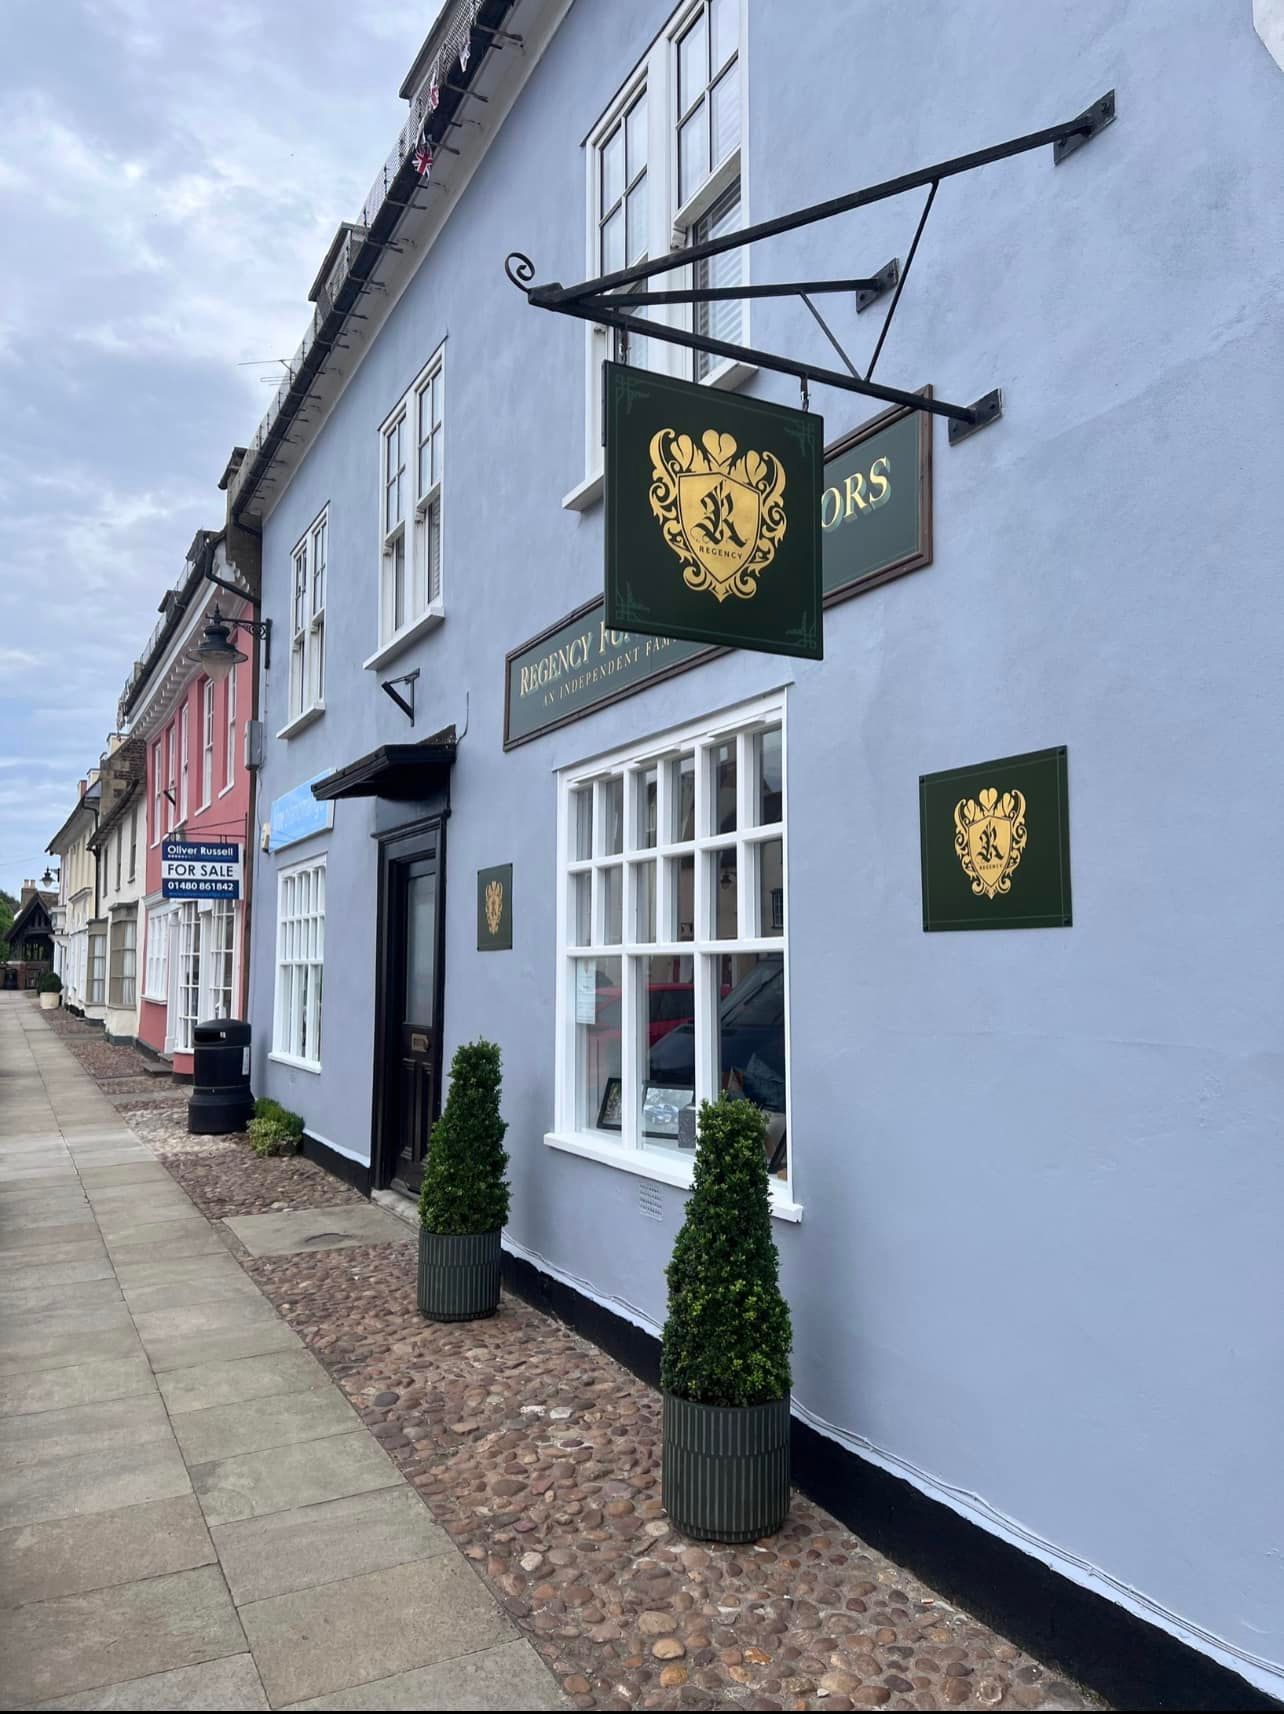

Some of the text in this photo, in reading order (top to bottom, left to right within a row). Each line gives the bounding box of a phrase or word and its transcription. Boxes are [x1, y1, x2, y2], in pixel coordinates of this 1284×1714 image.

[698, 545, 743, 560] REGENCY
[519, 631, 593, 698] REGENCY
[559, 646, 640, 700] INDEPENDENT
[645, 636, 677, 656] FAM
[167, 845, 234, 856] Oliver Russell
[167, 863, 234, 877] FOR SALE
[167, 881, 234, 891] 01480 861842
